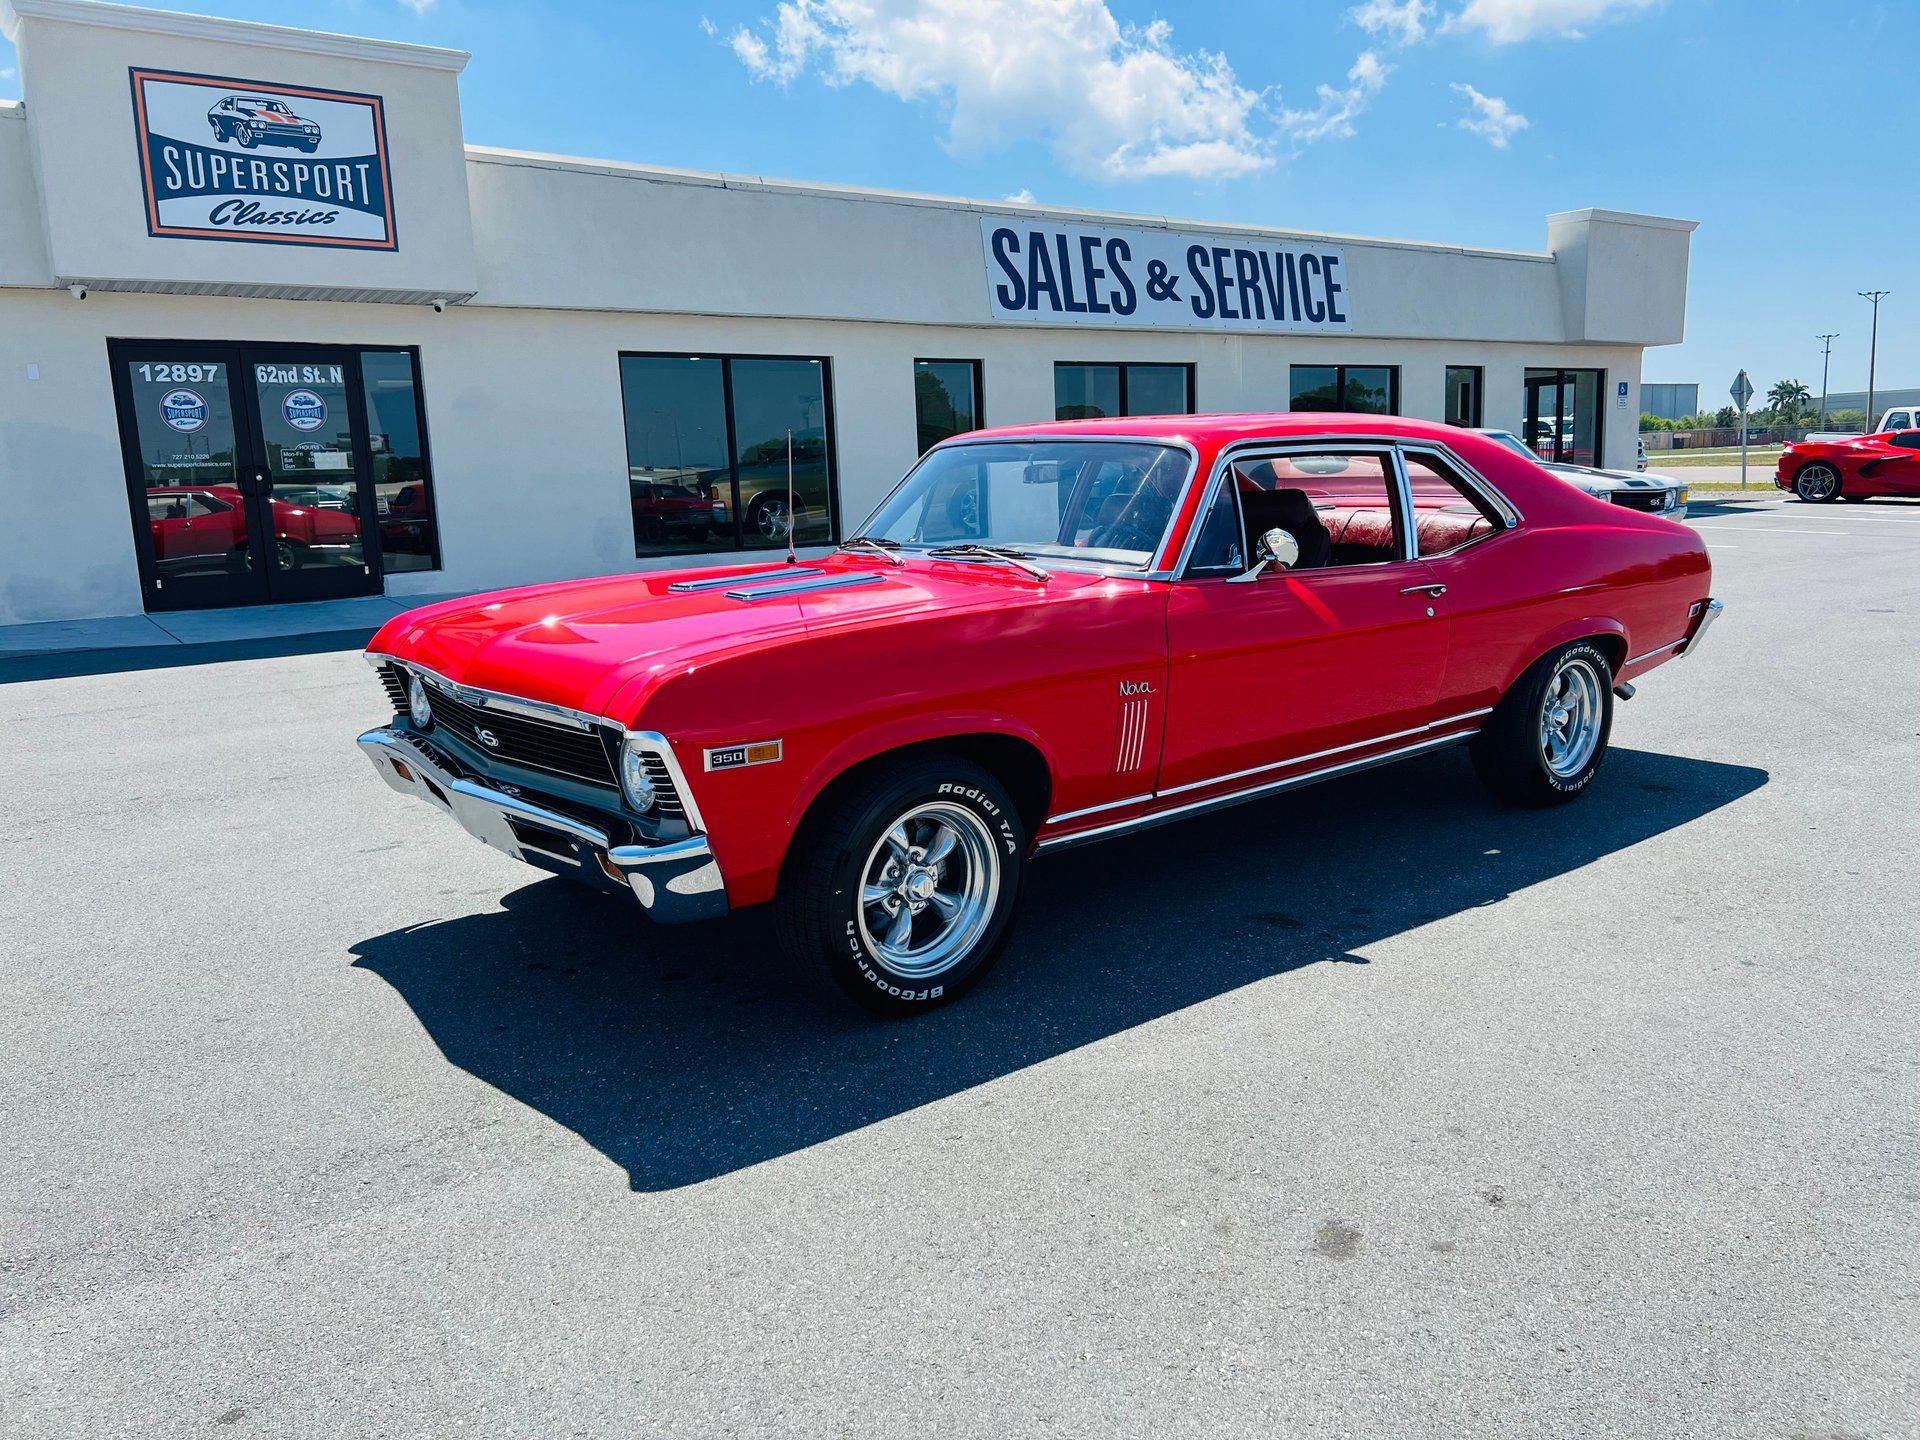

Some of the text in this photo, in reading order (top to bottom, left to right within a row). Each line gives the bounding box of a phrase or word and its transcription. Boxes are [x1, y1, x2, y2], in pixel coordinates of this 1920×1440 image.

[163, 145, 370, 205] SUPERSPORT
[209, 199, 340, 226] Classics
[991, 227, 1346, 323] SALES & SERVICE
[139, 364, 218, 382] 12897
[257, 366, 343, 383] 62nd St. N
[167, 407, 202, 419] SUPERSPORT
[289, 407, 321, 419] SUPERSPORT
[1553, 646, 1606, 673] BFGoodrich
[1120, 680, 1157, 696] Nova
[712, 752, 743, 764] 350
[1564, 768, 1595, 792] Radial
[938, 783, 1017, 855] Radial T/A
[846, 920, 944, 1001] BFGoodrich
